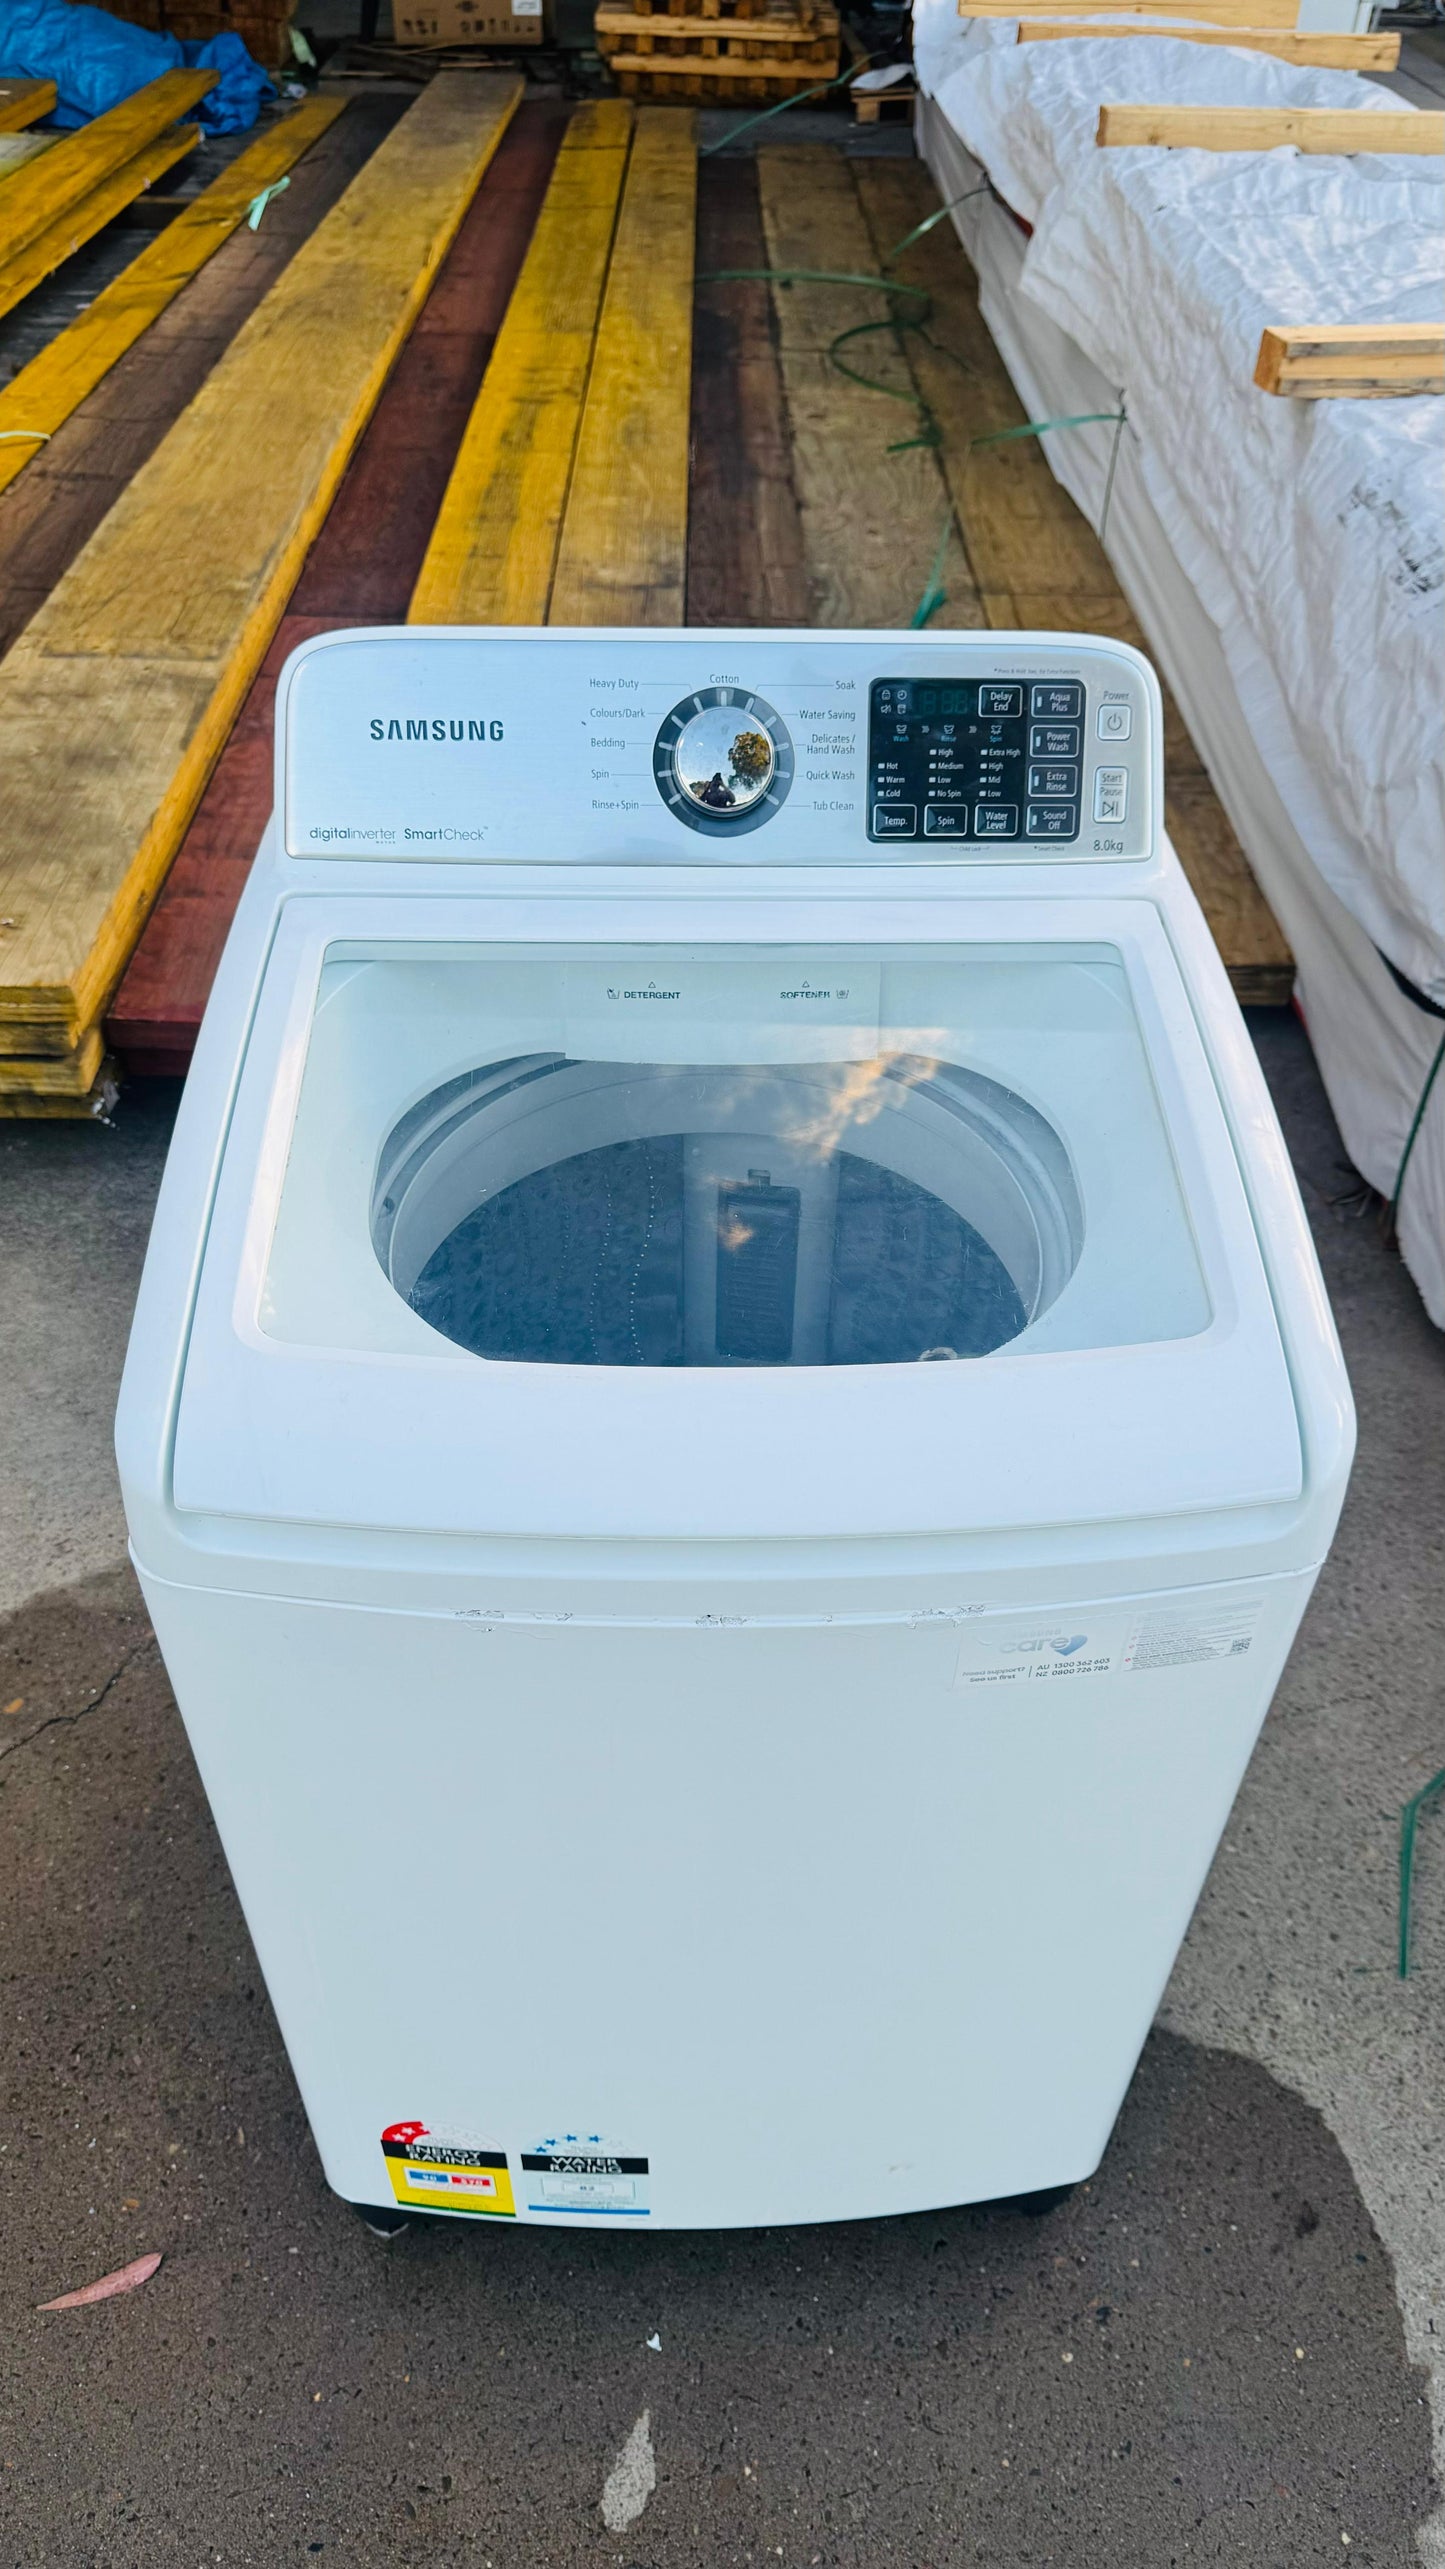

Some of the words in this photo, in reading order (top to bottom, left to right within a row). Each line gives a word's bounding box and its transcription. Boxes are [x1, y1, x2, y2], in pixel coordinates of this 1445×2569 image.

[589, 678, 615, 690] Heavy
[618, 679, 640, 690] Duty
[709, 674, 739, 684] Cotton
[835, 680, 856, 690] Soak
[990, 692, 1013, 703] Delay
[1049, 692, 1071, 703] Aqua
[1103, 691, 1130, 700] Power
[994, 702, 1009, 711] End
[1051, 702, 1068, 712] Plus
[590, 708, 646, 718] Colours/Dark
[799, 710, 825, 720] Water
[827, 710, 856, 722] Saving
[370, 719, 504, 741] SAMSUNG
[812, 734, 850, 743] Delicates
[1046, 732, 1071, 742] Power
[590, 738, 626, 749] Bedding
[1047, 742, 1069, 751] Wash
[806, 745, 830, 754] Hand
[831, 745, 856, 754] Wash
[938, 749, 954, 758] High
[988, 749, 1005, 757] Extra
[1006, 749, 1021, 758] High
[886, 762, 898, 770] Hot
[937, 762, 964, 770] Medium
[988, 762, 1004, 772] High
[591, 769, 610, 780] Spin
[806, 771, 830, 781] Quick
[831, 771, 855, 780] Wash
[1046, 772, 1068, 781] Extra
[1101, 773, 1123, 783] Start
[1046, 782, 1067, 791] Rinse
[1100, 787, 1124, 796] Pause
[947, 790, 961, 798] Spin
[591, 800, 640, 811] Rinse+Spin
[812, 801, 827, 811] Tub
[829, 801, 854, 811] Clean
[985, 812, 1008, 821] Water
[1042, 811, 1067, 820] Sound
[884, 816, 908, 827] Temp.
[937, 816, 955, 827] Spin
[986, 821, 1007, 829] Level
[1048, 820, 1061, 830] Off
[1093, 839, 1124, 854] 8.0kg
[623, 991, 681, 1000] DETERGENT
[779, 990, 831, 999] SOFTENER
[1054, 1661, 1075, 1669] 1300
[1051, 1668, 1075, 1676] 0800
[405, 2144, 481, 2159] ENERGY
[409, 2152, 481, 2167] RATING
[551, 2156, 618, 2166] WATER
[549, 2164, 622, 2174] RATING
